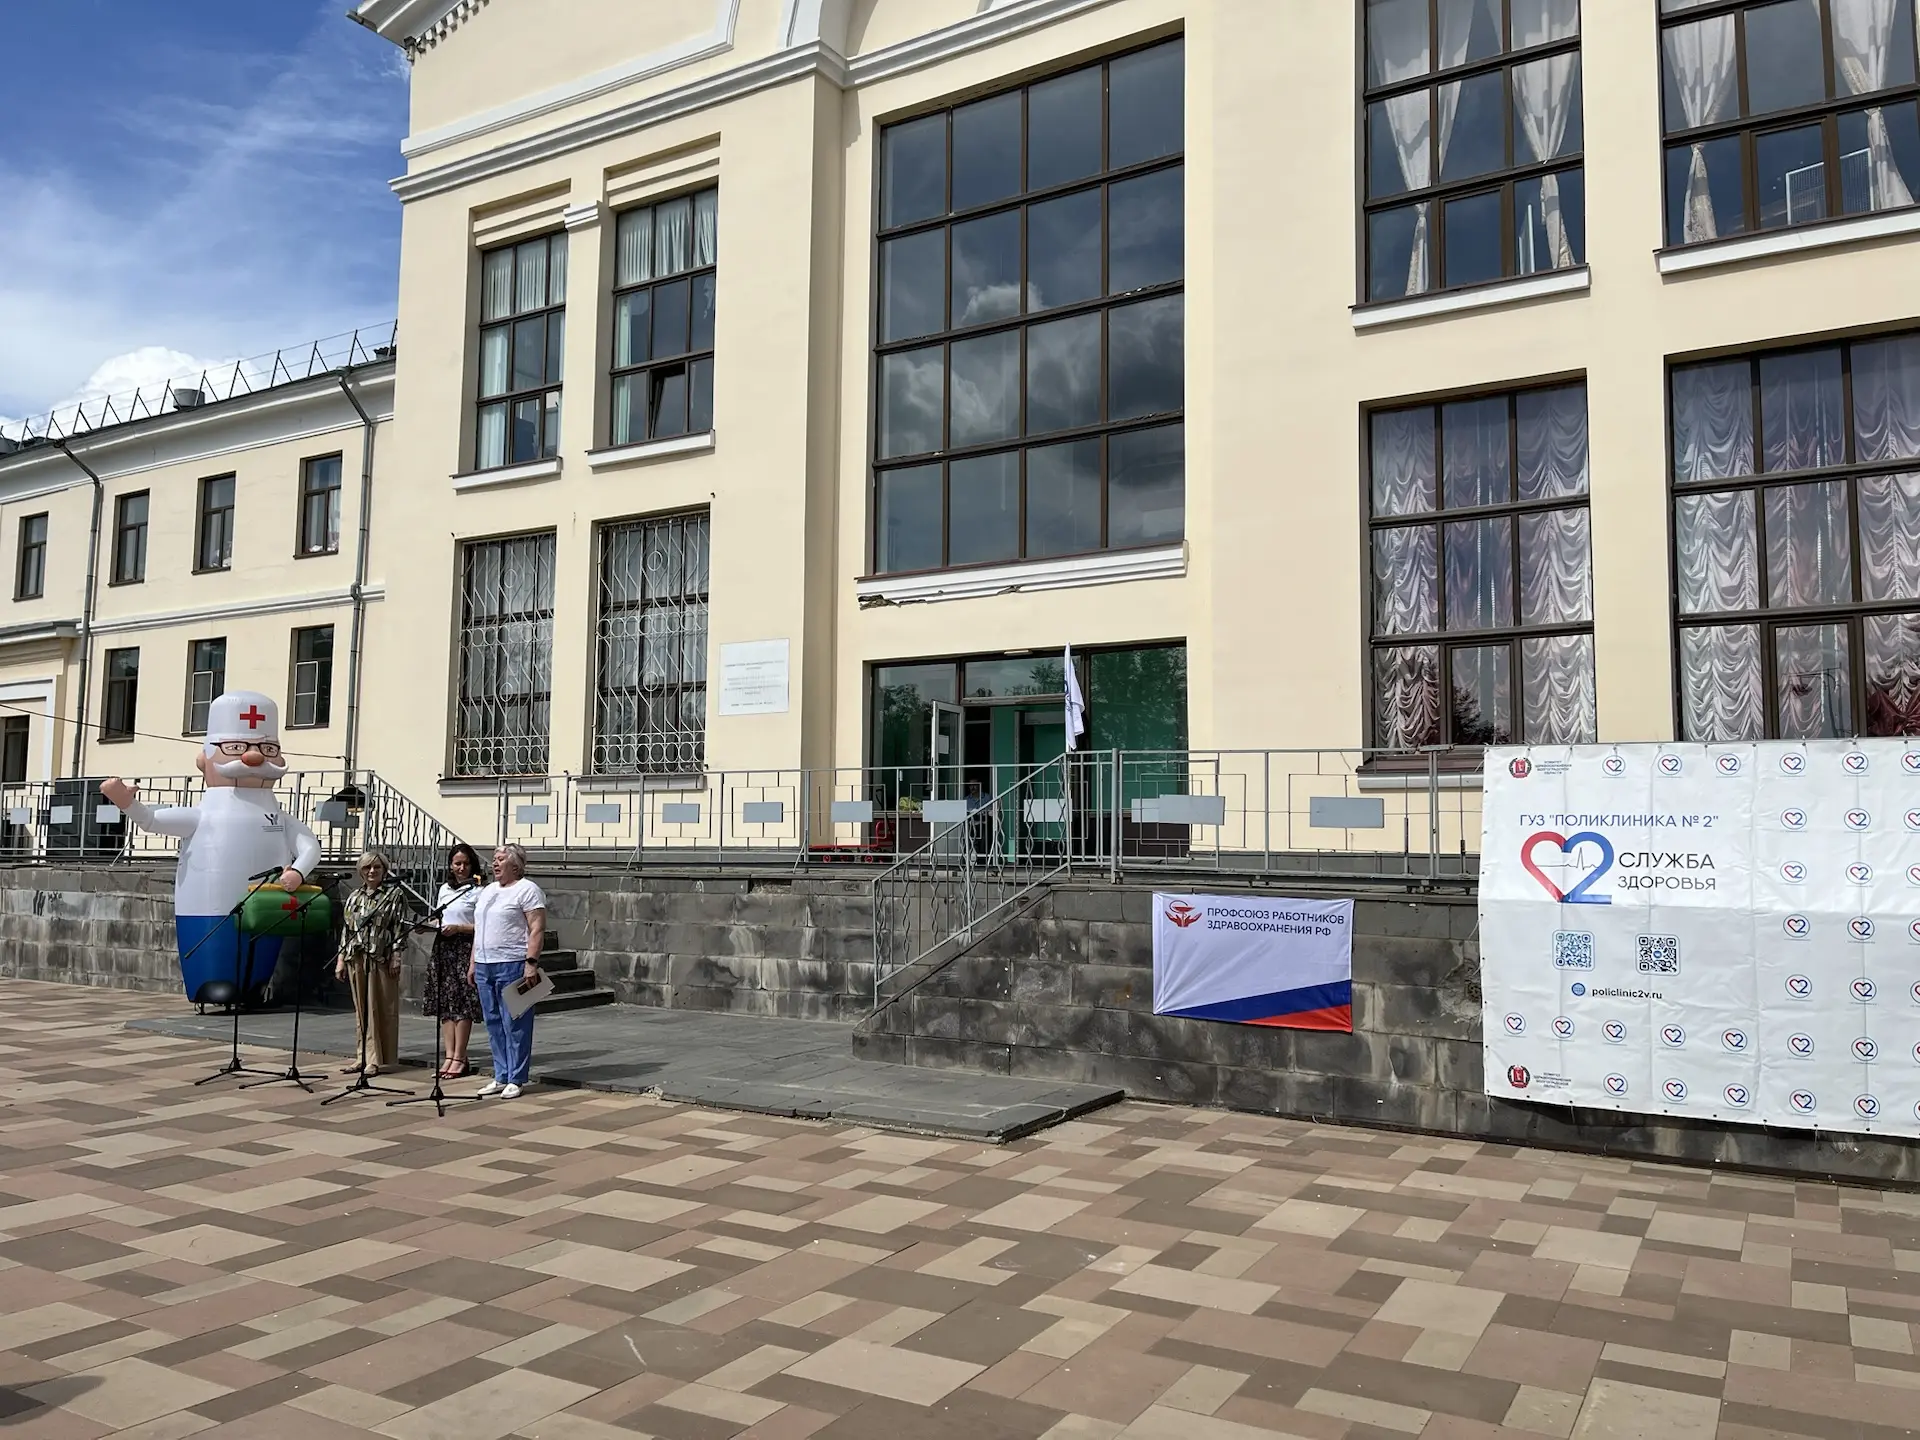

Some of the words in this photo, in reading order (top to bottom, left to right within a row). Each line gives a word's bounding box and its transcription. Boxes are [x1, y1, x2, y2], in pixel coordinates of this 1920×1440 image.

[1519, 814, 1545, 826] ГУЗ
[1550, 814, 1677, 828] "ПОЛИКЛИНИКА
[1682, 815, 1699, 827] №
[1703, 815, 1719, 828] 2"
[1618, 852, 1715, 869] СЛУЖБА
[1617, 876, 1716, 890] ЗДОРОВЬЯ
[1207, 908, 1269, 920] ПРОФСОЮЗ
[1272, 911, 1344, 924] РАБОТНИКОВ
[1207, 920, 1312, 935] ЗДРАВООХРАНЕНИЯ
[1315, 926, 1331, 936] РФ
[1592, 988, 1662, 999] policlinic2v.ru
